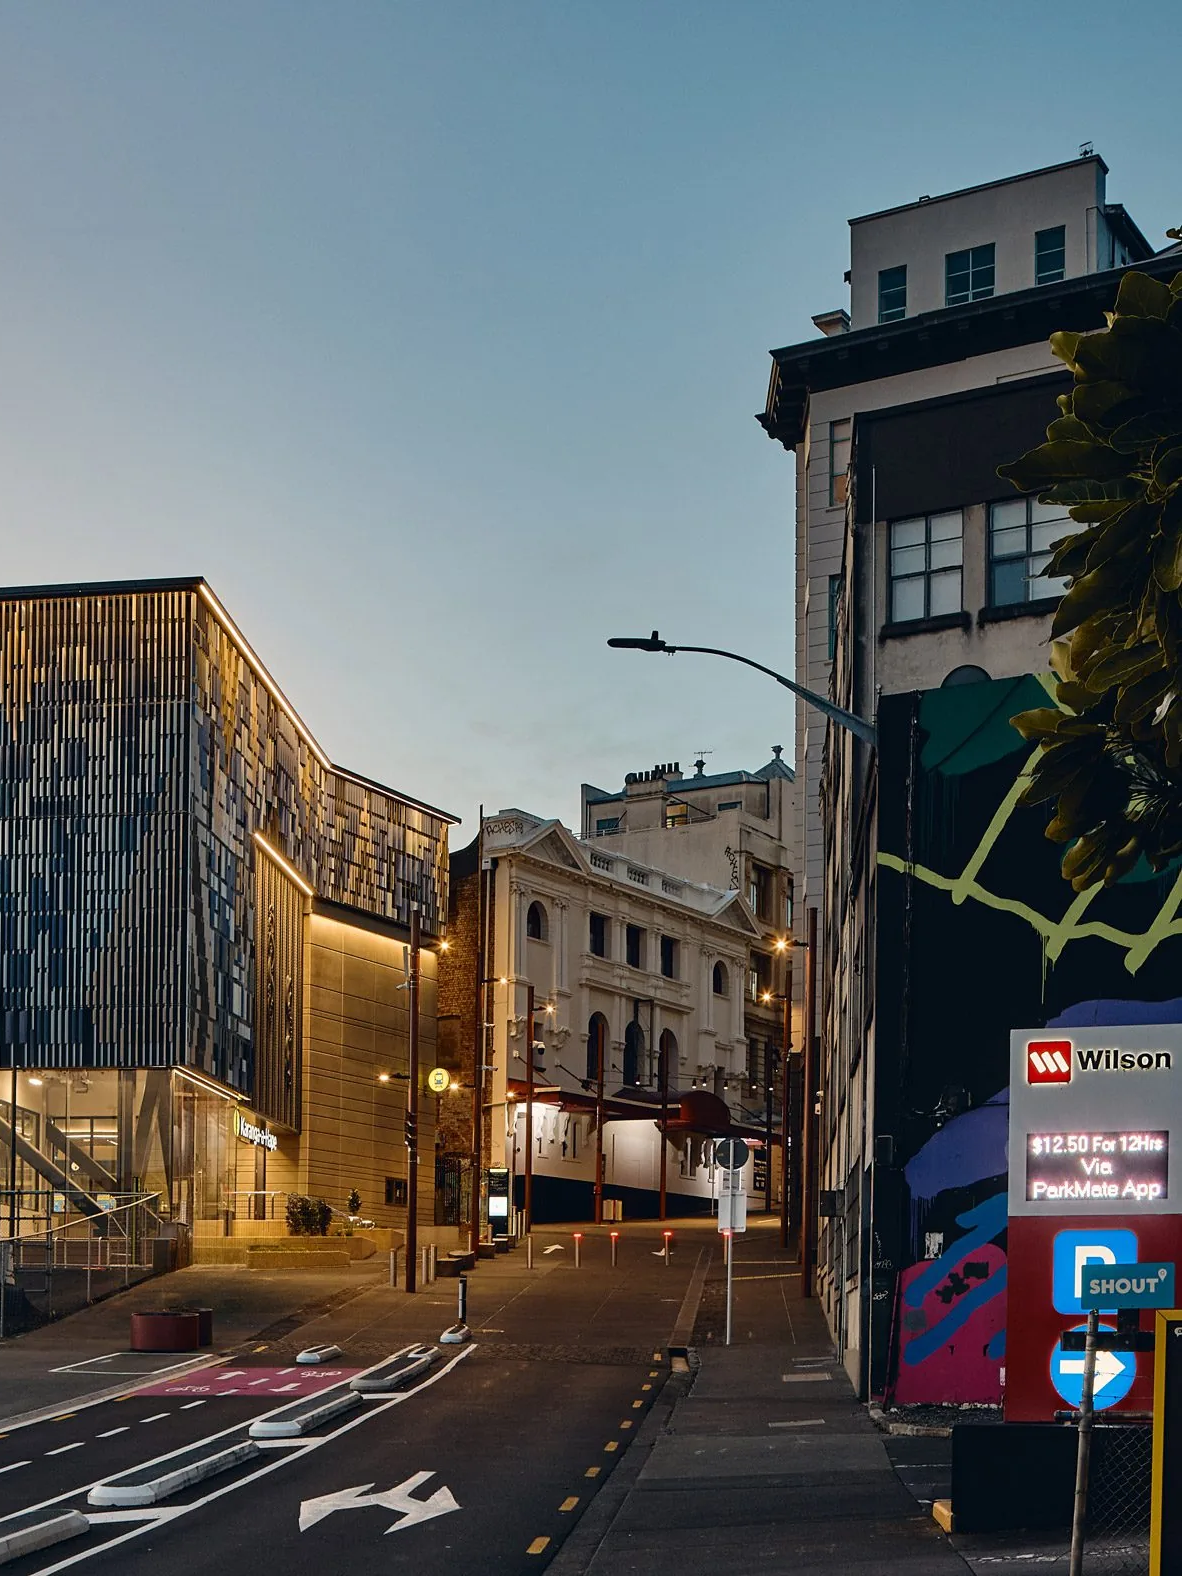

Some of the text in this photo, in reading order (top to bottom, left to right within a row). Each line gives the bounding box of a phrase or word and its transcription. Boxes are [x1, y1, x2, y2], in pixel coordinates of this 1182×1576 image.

[1077, 1050, 1171, 1070] Wilson
[1032, 1135, 1163, 1154] $12.50 For 12Hrs
[1080, 1157, 1113, 1175] Via
[1033, 1180, 1161, 1200] ParkMate App
[1089, 1278, 1158, 1294] SHOUT
